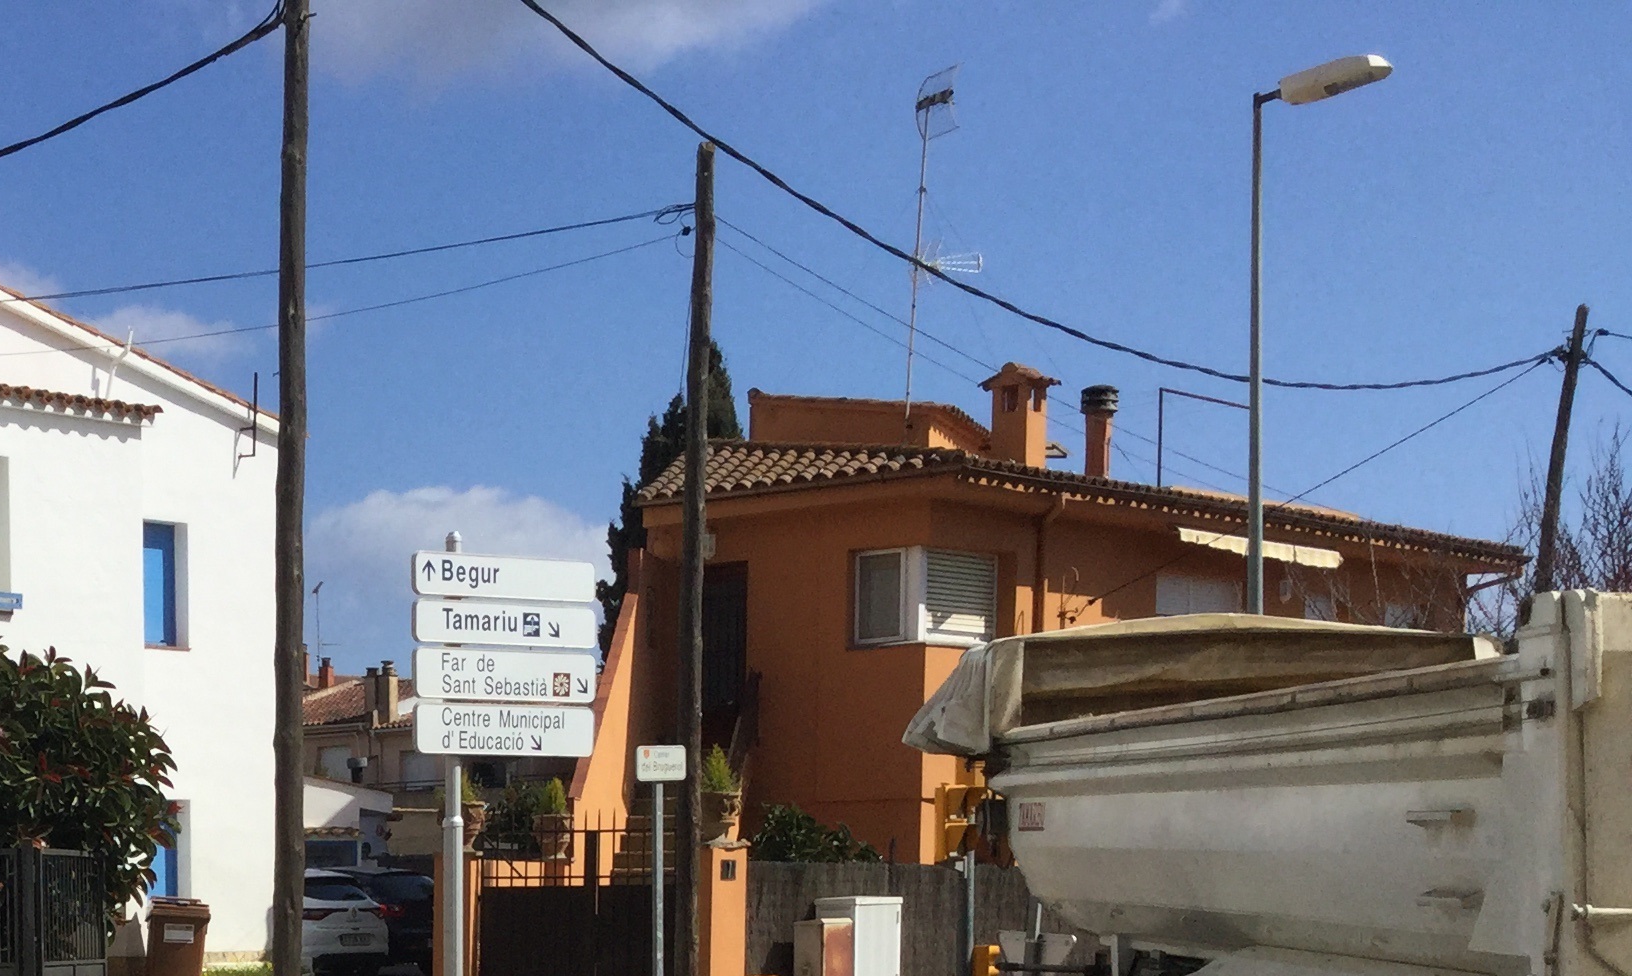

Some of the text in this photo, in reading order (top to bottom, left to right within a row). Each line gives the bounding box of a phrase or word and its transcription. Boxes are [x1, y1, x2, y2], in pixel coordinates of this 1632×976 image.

[441, 559, 500, 589] Begur
[442, 607, 518, 633] Tamariu
[441, 652, 495, 673] Far de
[441, 674, 548, 697] Sant Sebastià
[441, 707, 565, 733] Centre Municipal
